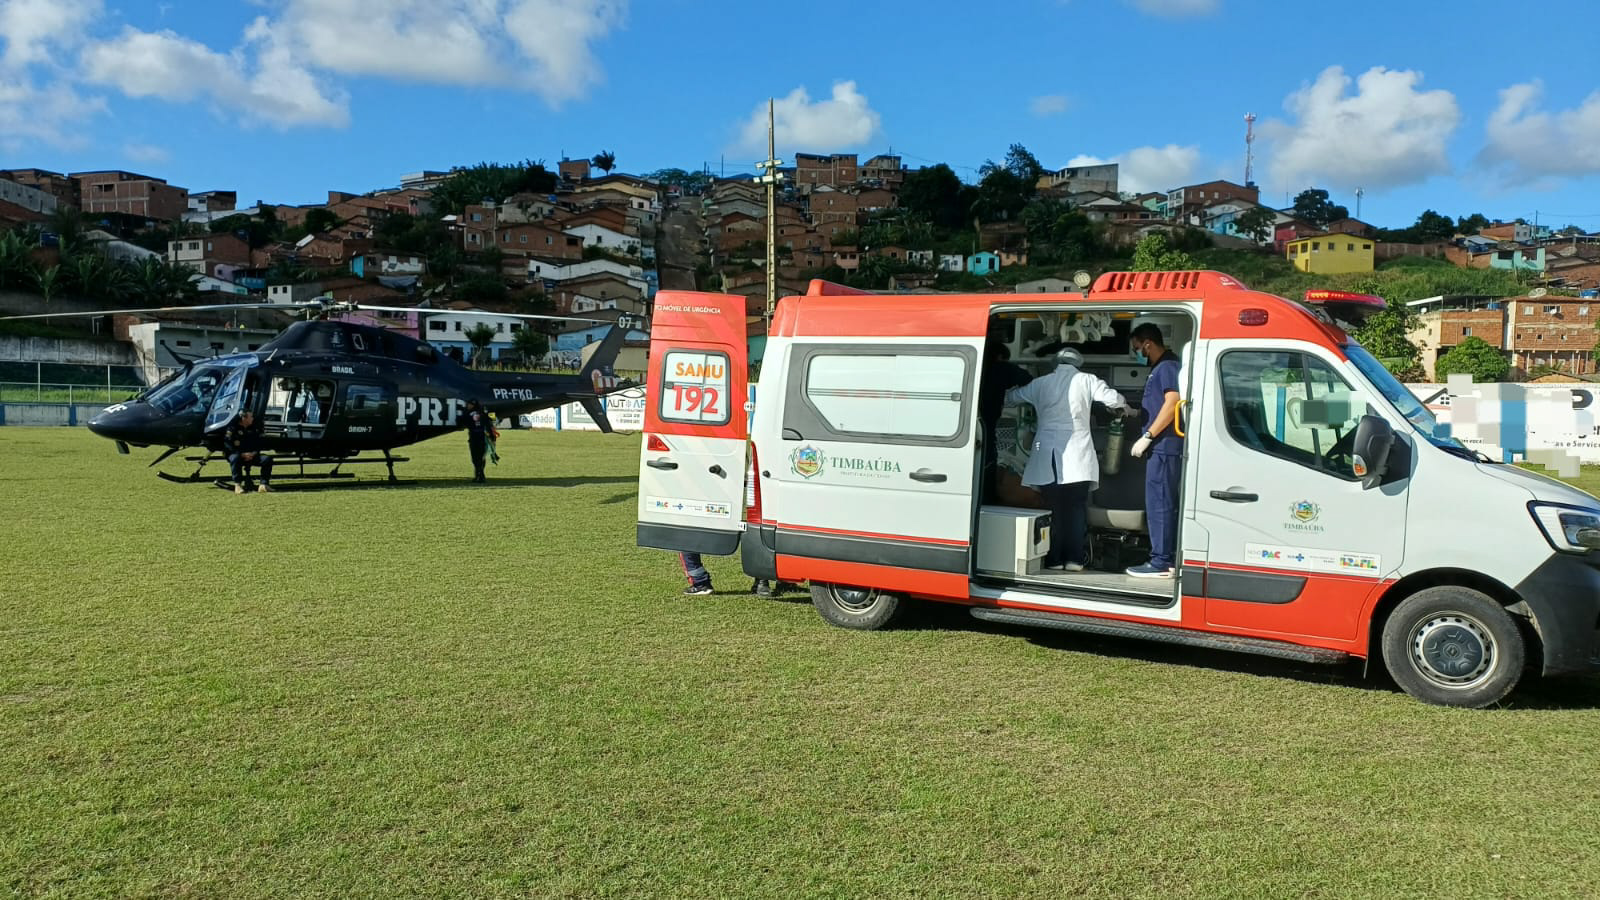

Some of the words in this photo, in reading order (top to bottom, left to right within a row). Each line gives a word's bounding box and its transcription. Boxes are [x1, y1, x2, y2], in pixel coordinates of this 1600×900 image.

[663, 304, 682, 312] MÓVEL
[692, 306, 721, 314] URGÊNCIA
[618, 316, 632, 329] 07
[675, 362, 724, 378] SAMU
[672, 386, 719, 414] 192
[831, 456, 902, 473] TIMBAÚBA
[1262, 550, 1281, 558] PAC
